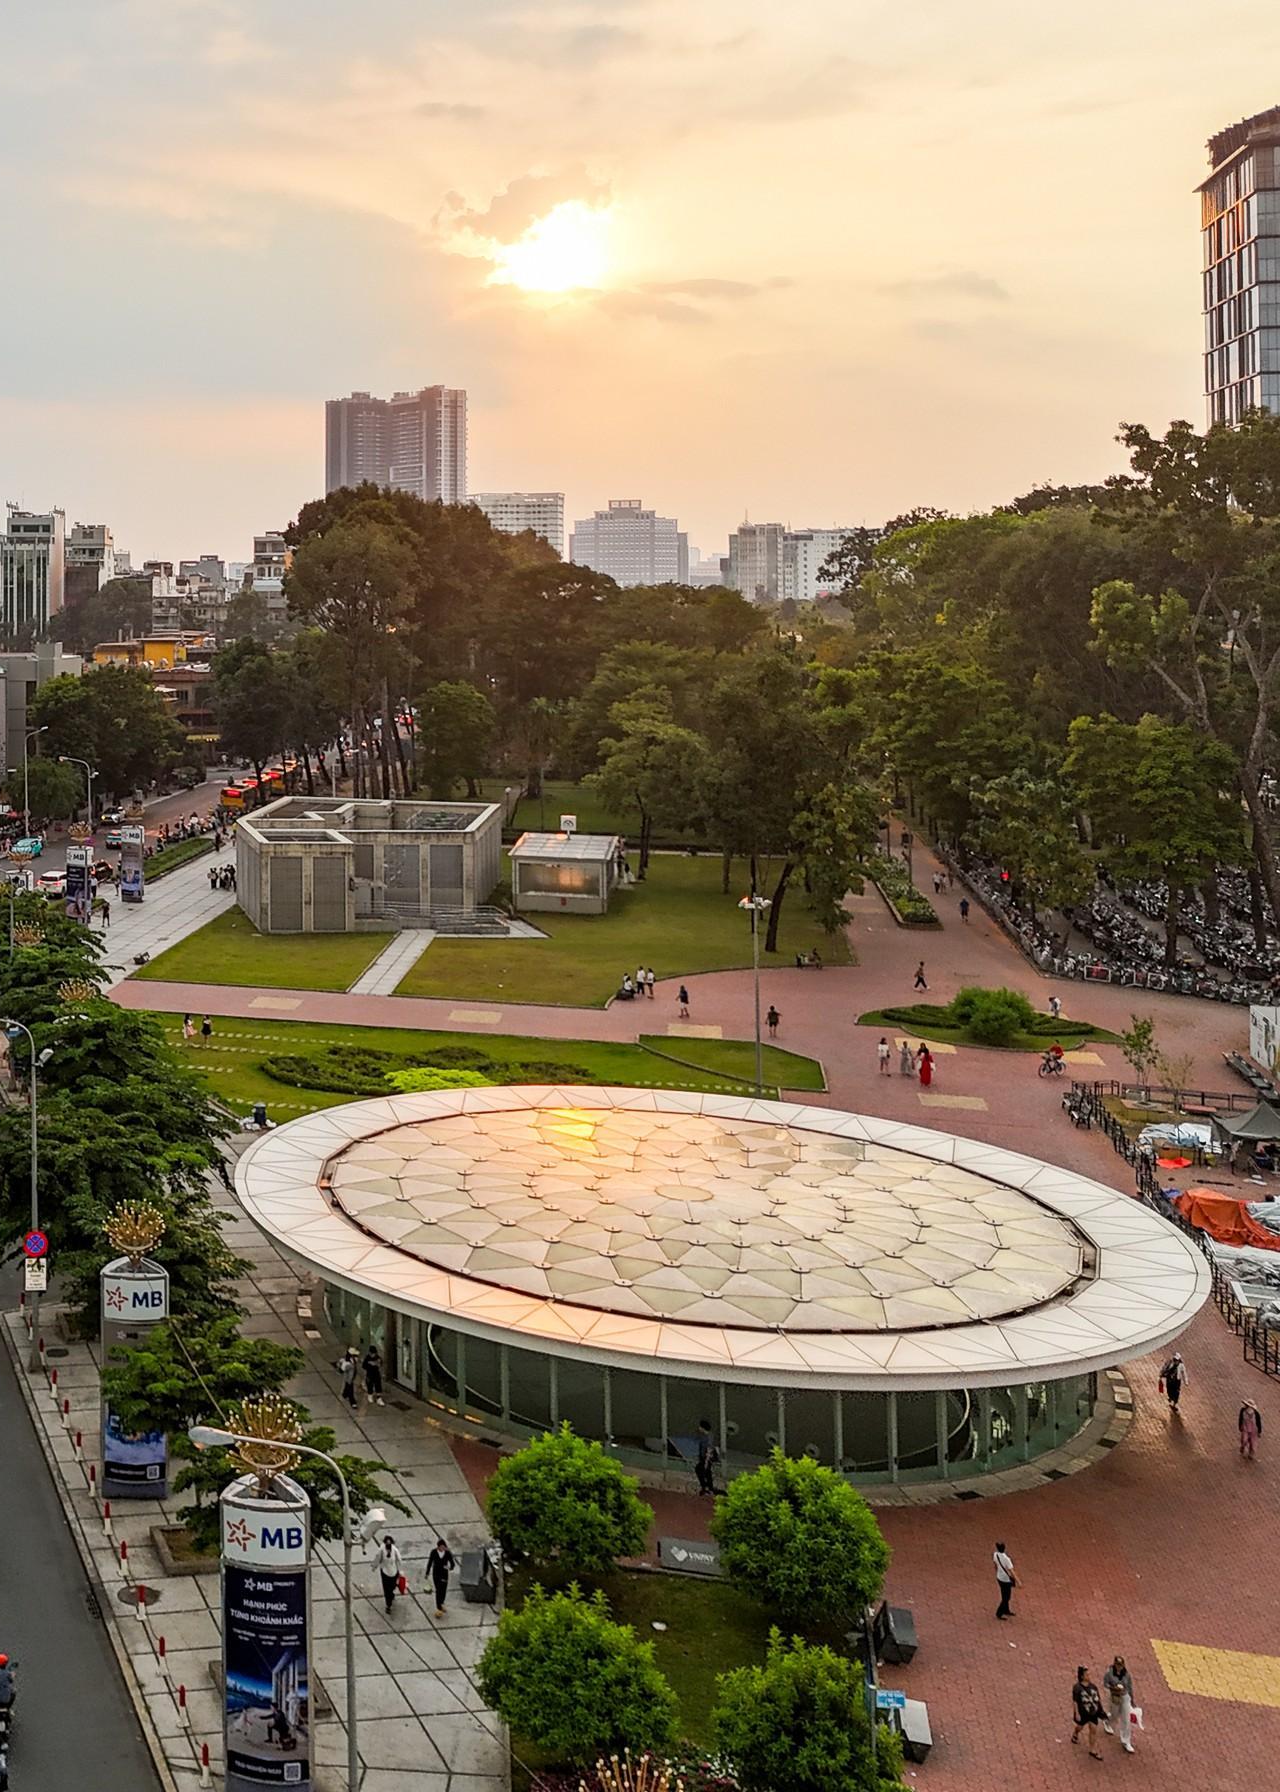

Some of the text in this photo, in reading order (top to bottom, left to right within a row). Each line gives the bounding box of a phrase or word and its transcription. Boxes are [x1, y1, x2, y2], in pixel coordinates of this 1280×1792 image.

[128, 831, 140, 839] MB
[132, 1291, 163, 1308] MB
[260, 1527, 303, 1549] MB
[256, 1581, 273, 1591] MB
